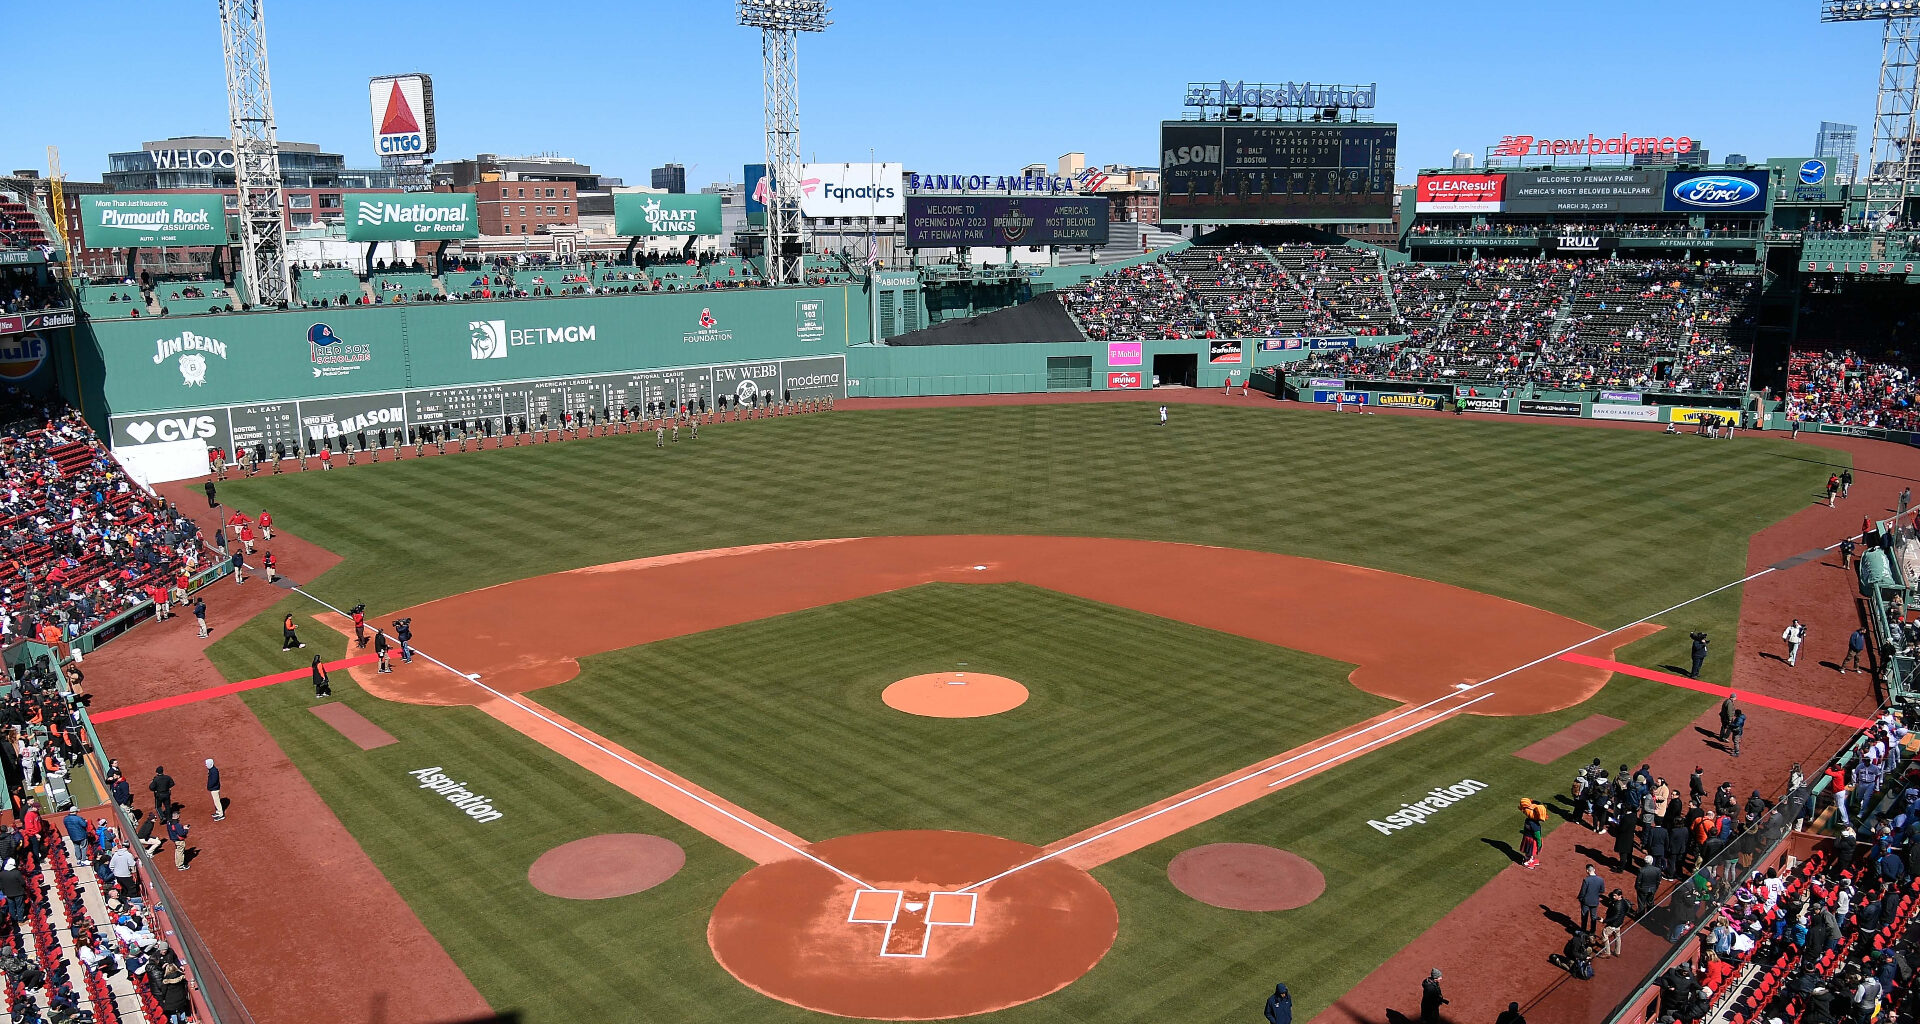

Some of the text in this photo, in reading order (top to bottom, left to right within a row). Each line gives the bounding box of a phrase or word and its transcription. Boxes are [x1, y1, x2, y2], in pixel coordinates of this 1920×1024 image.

[1220, 80, 1376, 108] MassMutual
[380, 134, 421, 152] CITGO
[1538, 132, 1692, 155] new balance
[910, 174, 1074, 192] BANK OF AMERICA
[1428, 180, 1496, 191] CLEAResult
[824, 182, 894, 199] Fanatics
[1688, 180, 1743, 201] Ford
[645, 206, 697, 222] DRAFT
[927, 206, 975, 215] WELCOME TO
[1054, 206, 1089, 215] AMERICA'S
[102, 209, 208, 226] Plymouth Rock
[914, 218, 987, 228] OPENING DAY 2023
[993, 217, 1034, 227] OPENING DAY
[1046, 218, 1096, 227] MOST BELOVED
[414, 224, 464, 232] Car Rental
[652, 220, 696, 232] KINGS
[919, 230, 984, 240] AT FENWAY PARK
[1053, 229, 1089, 238] BALLPARK
[1557, 236, 1600, 248] TRULY
[4, 254, 29, 262] MATTER
[1826, 262, 1834, 271] 4
[1878, 263, 1894, 272] 27
[882, 278, 916, 286] ABIOMED
[43, 316, 74, 327] Safelite
[510, 325, 596, 346] BETMGM
[683, 334, 732, 344] FOUNDATION
[0, 340, 42, 360] ulf
[152, 331, 227, 364] JIM BEAM
[316, 343, 371, 356] RED SOX
[316, 354, 371, 365] SCHOLARS
[740, 365, 777, 378] WEBB
[787, 373, 839, 387] moderna
[430, 390, 469, 398] FENWAY
[1326, 391, 1356, 402] jetlue
[1380, 395, 1416, 404] GRANITE
[1418, 396, 1436, 407] CITY
[1466, 400, 1502, 408] wasabi
[302, 415, 335, 426] WHO BUT
[156, 415, 217, 442] CVS
[234, 432, 263, 440] BALTIMORE
[408, 766, 503, 824] Aspiration
[1366, 779, 1489, 836] Aspiration
